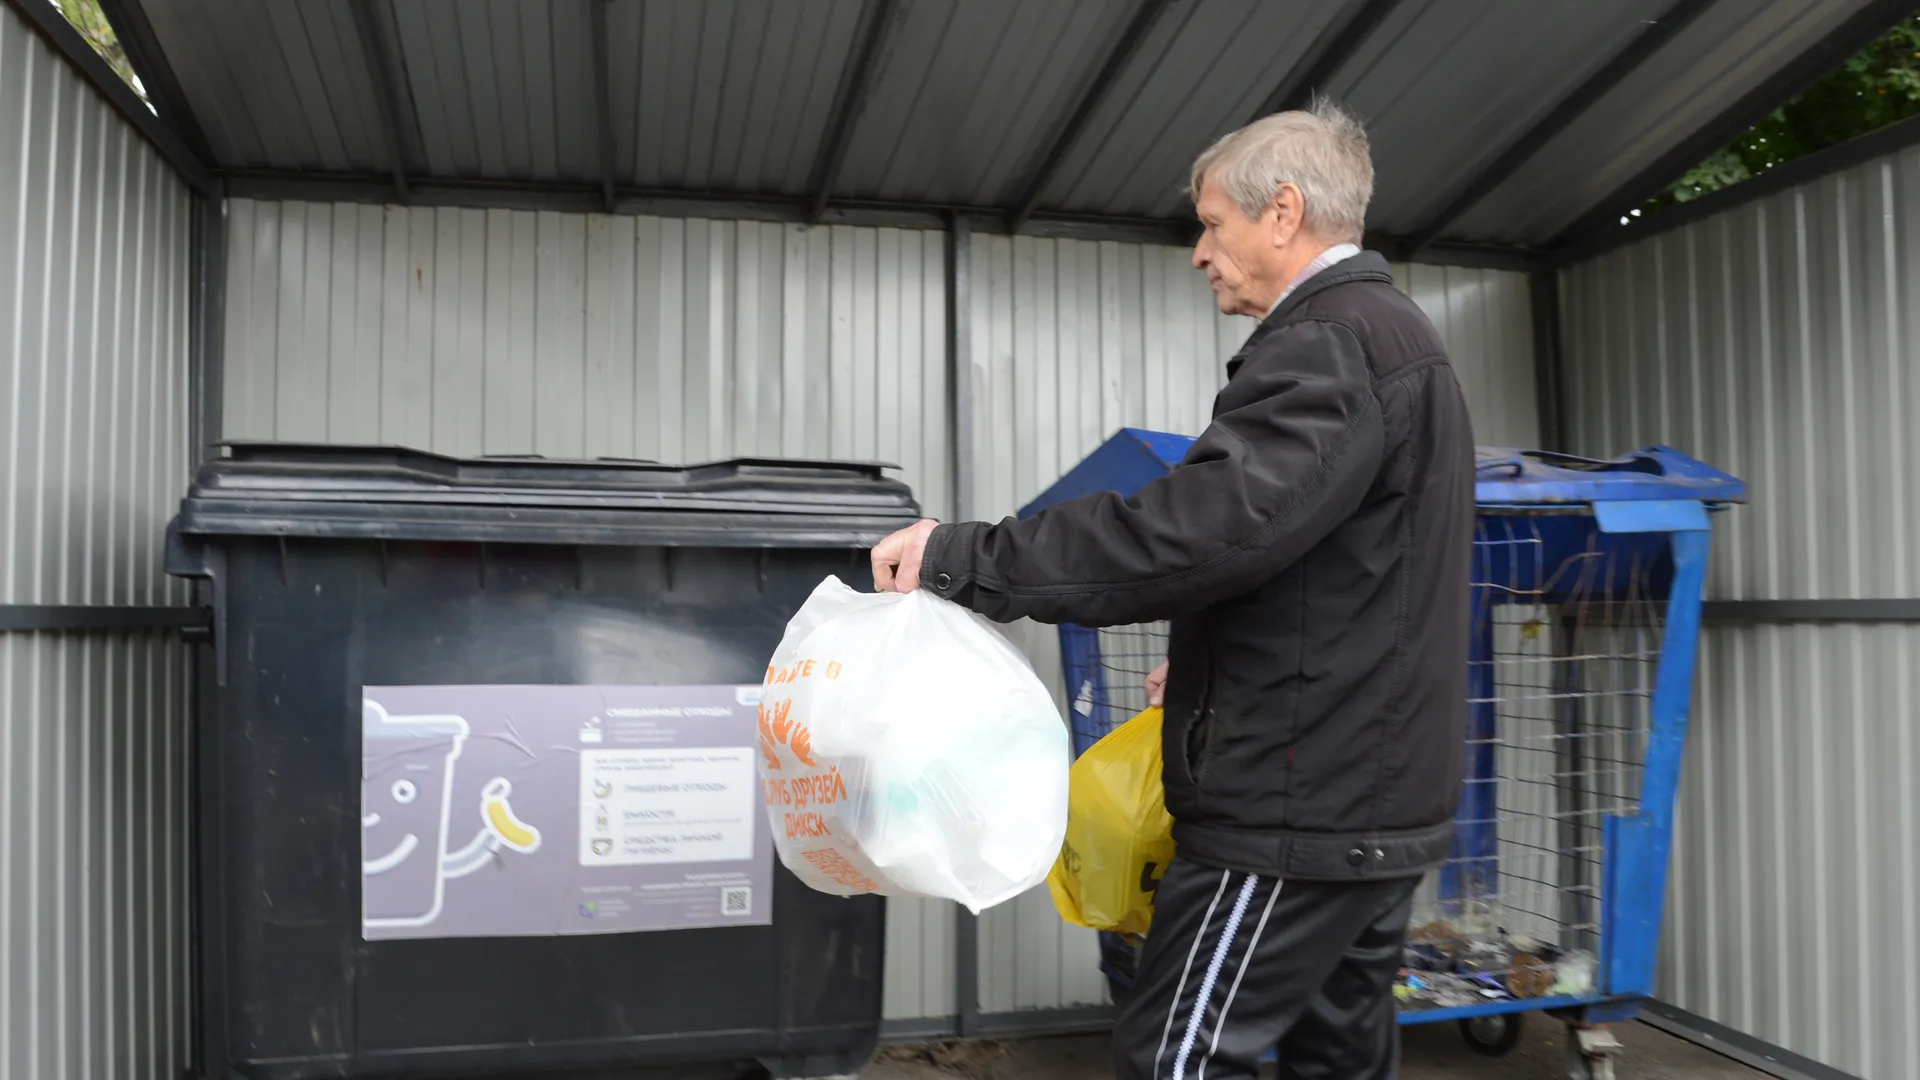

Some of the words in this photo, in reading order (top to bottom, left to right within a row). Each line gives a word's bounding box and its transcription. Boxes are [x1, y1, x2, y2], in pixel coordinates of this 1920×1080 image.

[762, 778, 791, 805] ЛУБ
[791, 765, 848, 810] ДРУЗЕЙ
[785, 812, 832, 840] ДИКСИ
